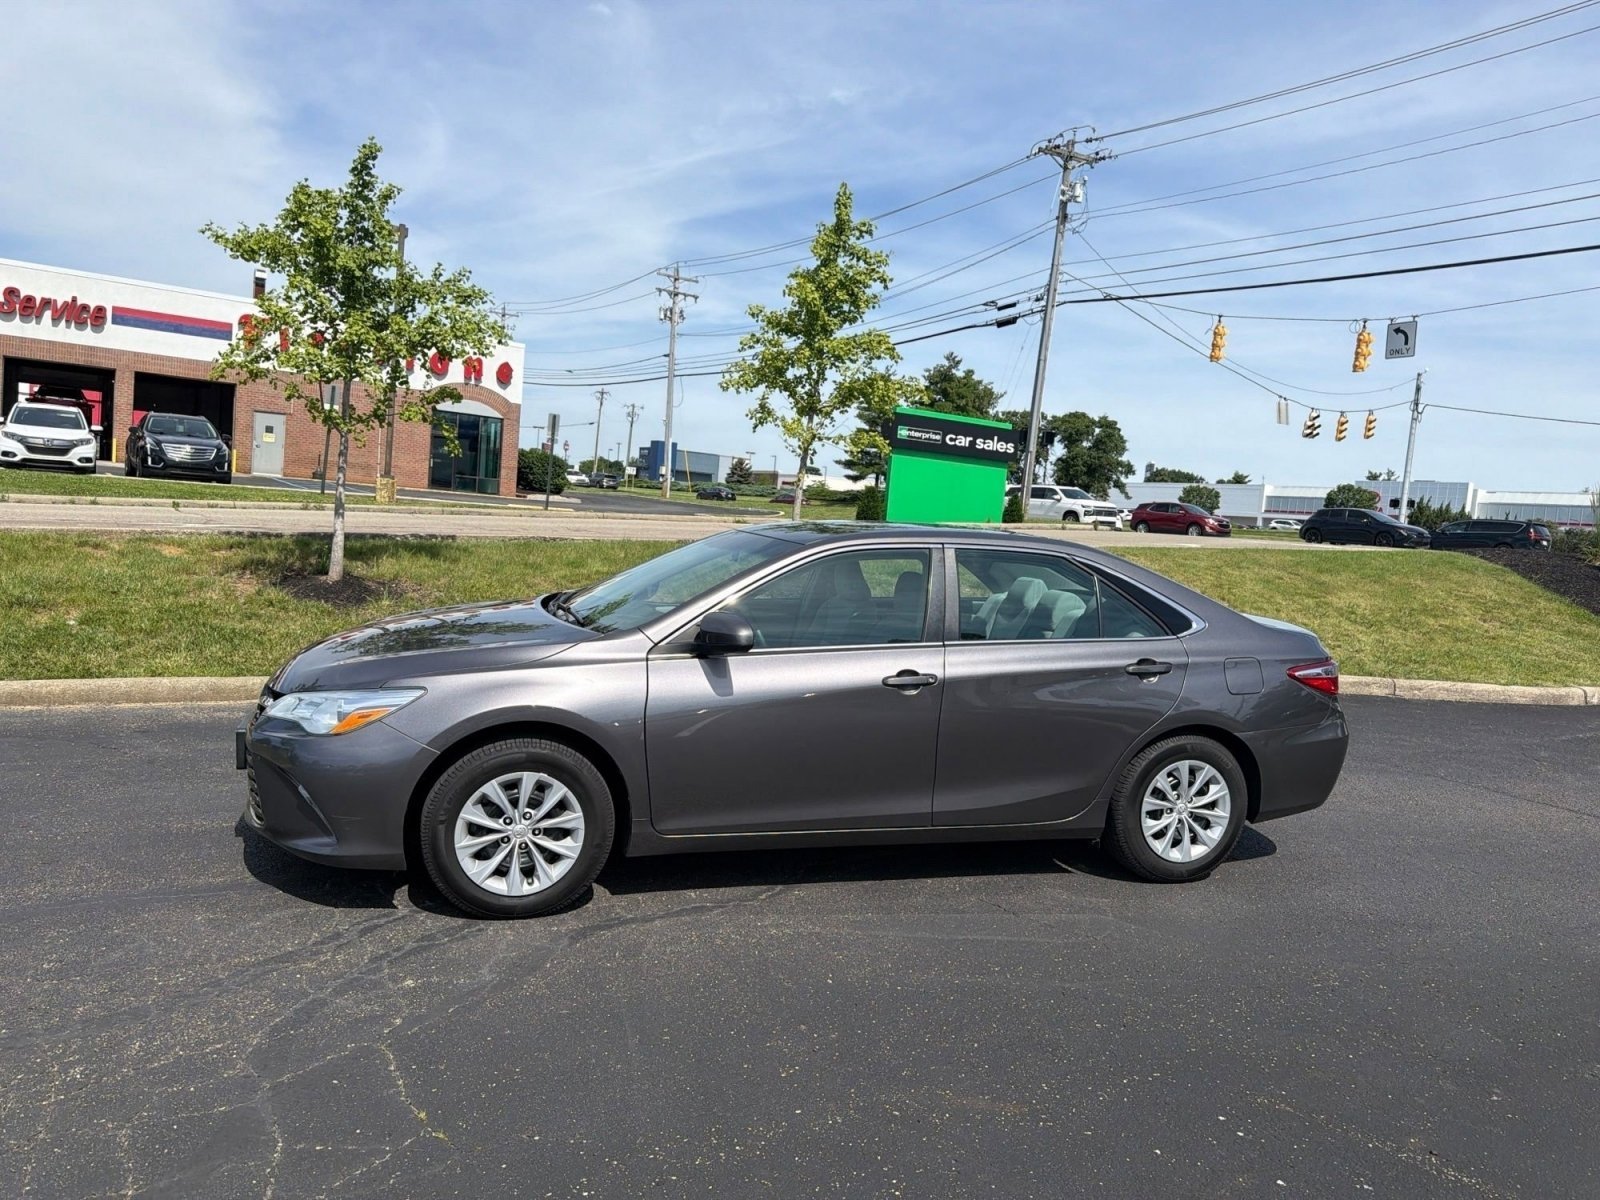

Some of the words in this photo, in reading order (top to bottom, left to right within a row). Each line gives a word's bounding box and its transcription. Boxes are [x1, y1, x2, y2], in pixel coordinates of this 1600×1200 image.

[0, 286, 107, 327] Service
[1389, 346, 1411, 356] ONLY
[898, 429, 941, 441] enterprise
[945, 433, 973, 447] car
[975, 436, 1015, 453] sales
